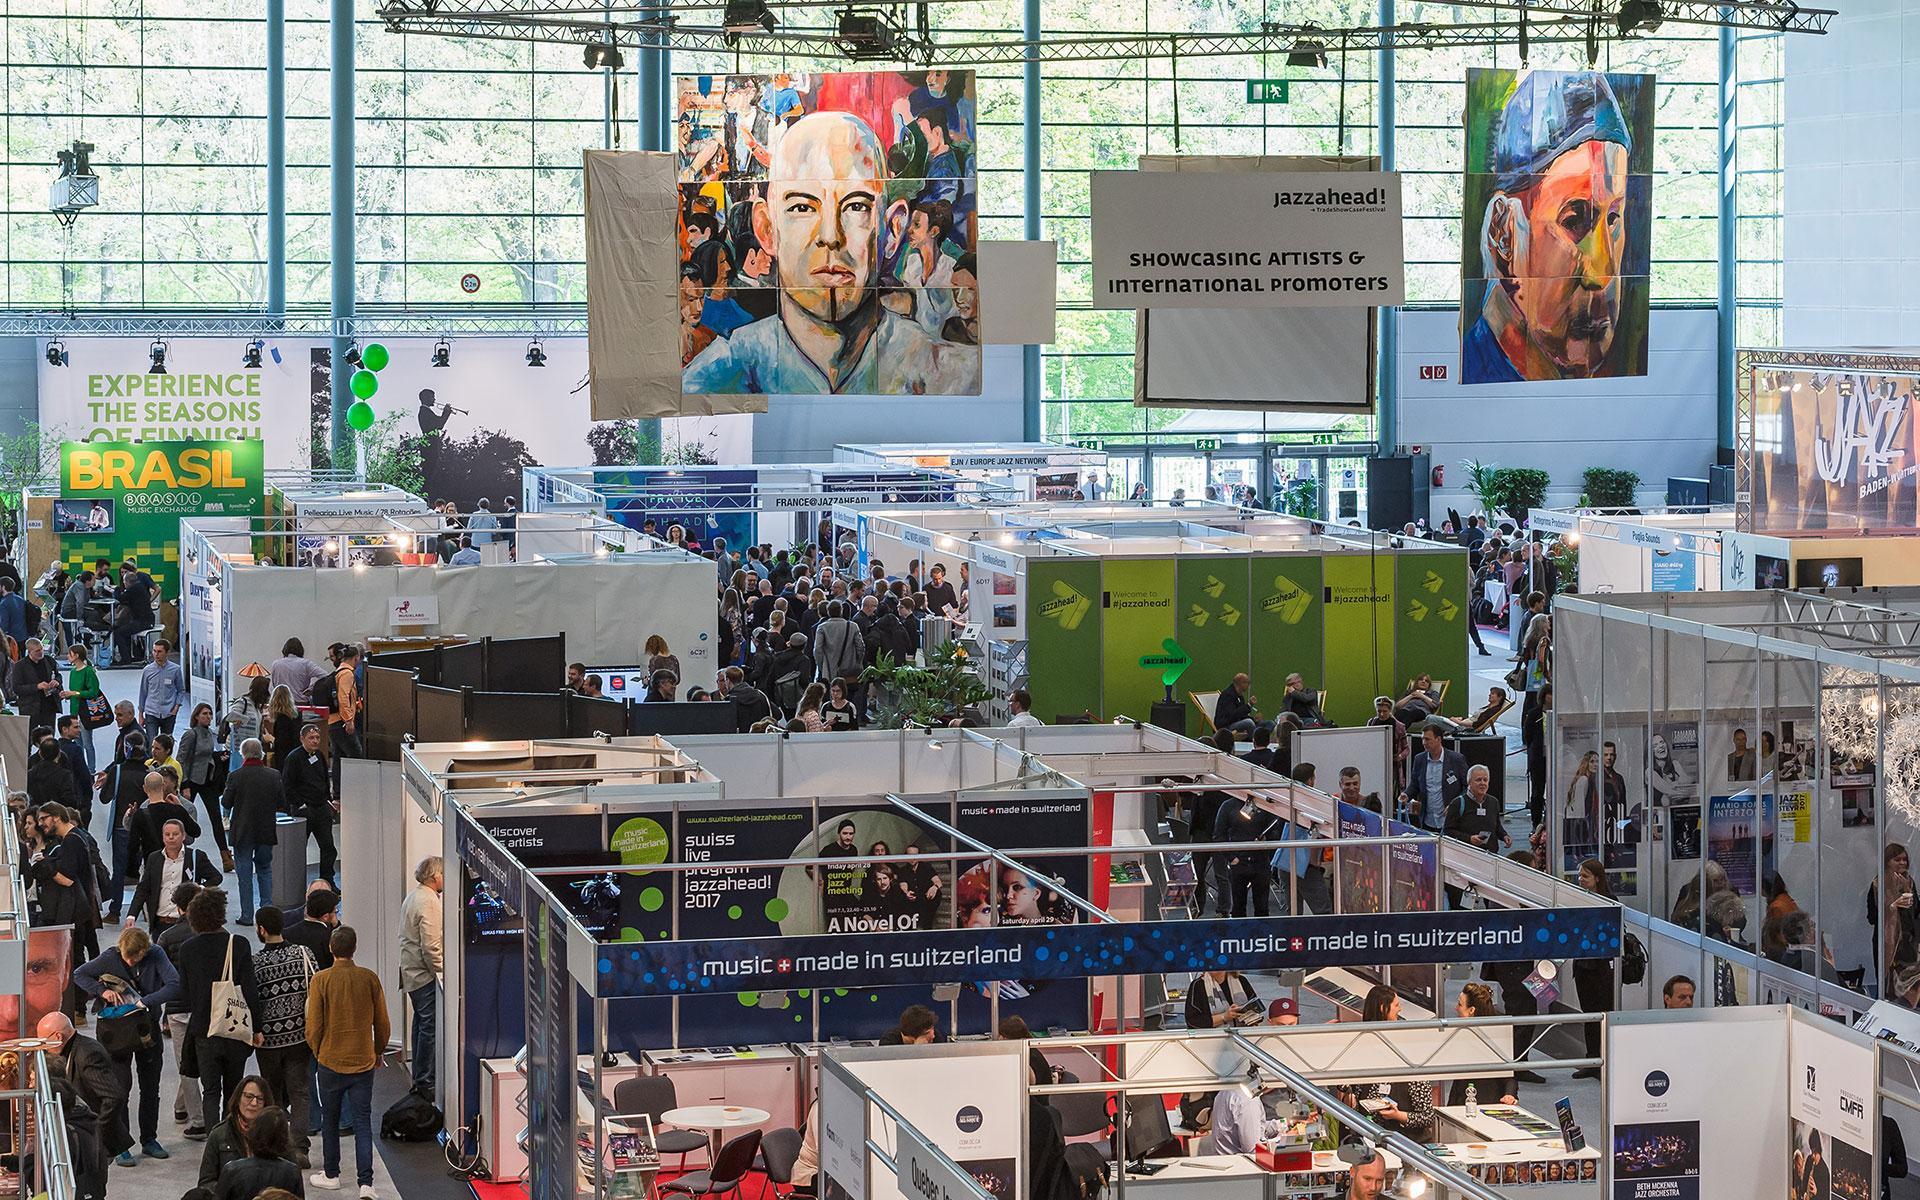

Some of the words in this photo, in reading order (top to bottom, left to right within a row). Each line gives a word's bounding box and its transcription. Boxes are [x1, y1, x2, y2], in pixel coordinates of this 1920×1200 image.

[1273, 187, 1386, 208] jazzahead!
[1348, 250, 1366, 266] &
[88, 374, 261, 397] EXPERIENCE
[87, 402, 137, 422] THE
[144, 401, 261, 423] SEASONS
[1015, 457, 1047, 465] NETWORK
[69, 448, 247, 490] BRASIL
[123, 492, 202, 506] BRASIL
[776, 496, 870, 507] FRANCE@JAZZAHEAD!
[127, 506, 152, 514] MUSIC
[1632, 530, 1645, 542] Puglia
[1644, 533, 1661, 545] Sounds
[1038, 594, 1078, 614] jazzahead!
[1113, 598, 1170, 609] #jazzahead!
[1262, 589, 1300, 608] jazzahead!
[1334, 593, 1390, 605] #jazzahead!
[1143, 657, 1187, 665] jazzahead!
[1778, 794, 1800, 805] JAZZ
[961, 806, 988, 816] music
[995, 805, 1020, 815] made
[1021, 805, 1030, 814] in
[1031, 804, 1081, 814] switzerland
[1713, 809, 1767, 818] INTERZOE
[686, 813, 804, 824] www.switzerland-jazzahead.com
[489, 827, 537, 837] discover
[624, 828, 648, 838] music
[508, 837, 544, 848] artists
[613, 838, 635, 848] made
[619, 838, 667, 853] switzerland
[685, 832, 735, 847] swiss
[685, 848, 711, 862] live
[827, 871, 868, 880] european
[685, 875, 771, 894] jazzahead!
[827, 879, 844, 889] jazz
[827, 887, 863, 896] meeting
[685, 893, 721, 908] 2017
[828, 917, 841, 933] A
[844, 914, 893, 932] Novel
[897, 913, 919, 931] Of
[1002, 918, 1029, 926] saturday
[1030, 918, 1046, 926] april
[1220, 934, 1287, 954] music
[1307, 931, 1368, 951] made
[1374, 930, 1392, 949] in
[1397, 925, 1523, 948] switzerland
[703, 955, 773, 976] music
[796, 951, 858, 972] made
[865, 950, 885, 969] in
[890, 943, 1021, 968] switzerland
[1840, 1096, 1864, 1119] CMFR
[1636, 1183, 1651, 1191] BETH
[1652, 1181, 1678, 1190] MCKENNA
[1635, 1190, 1648, 1199] JAZZ
[1648, 1189, 1680, 1198] ORCHESTRA
